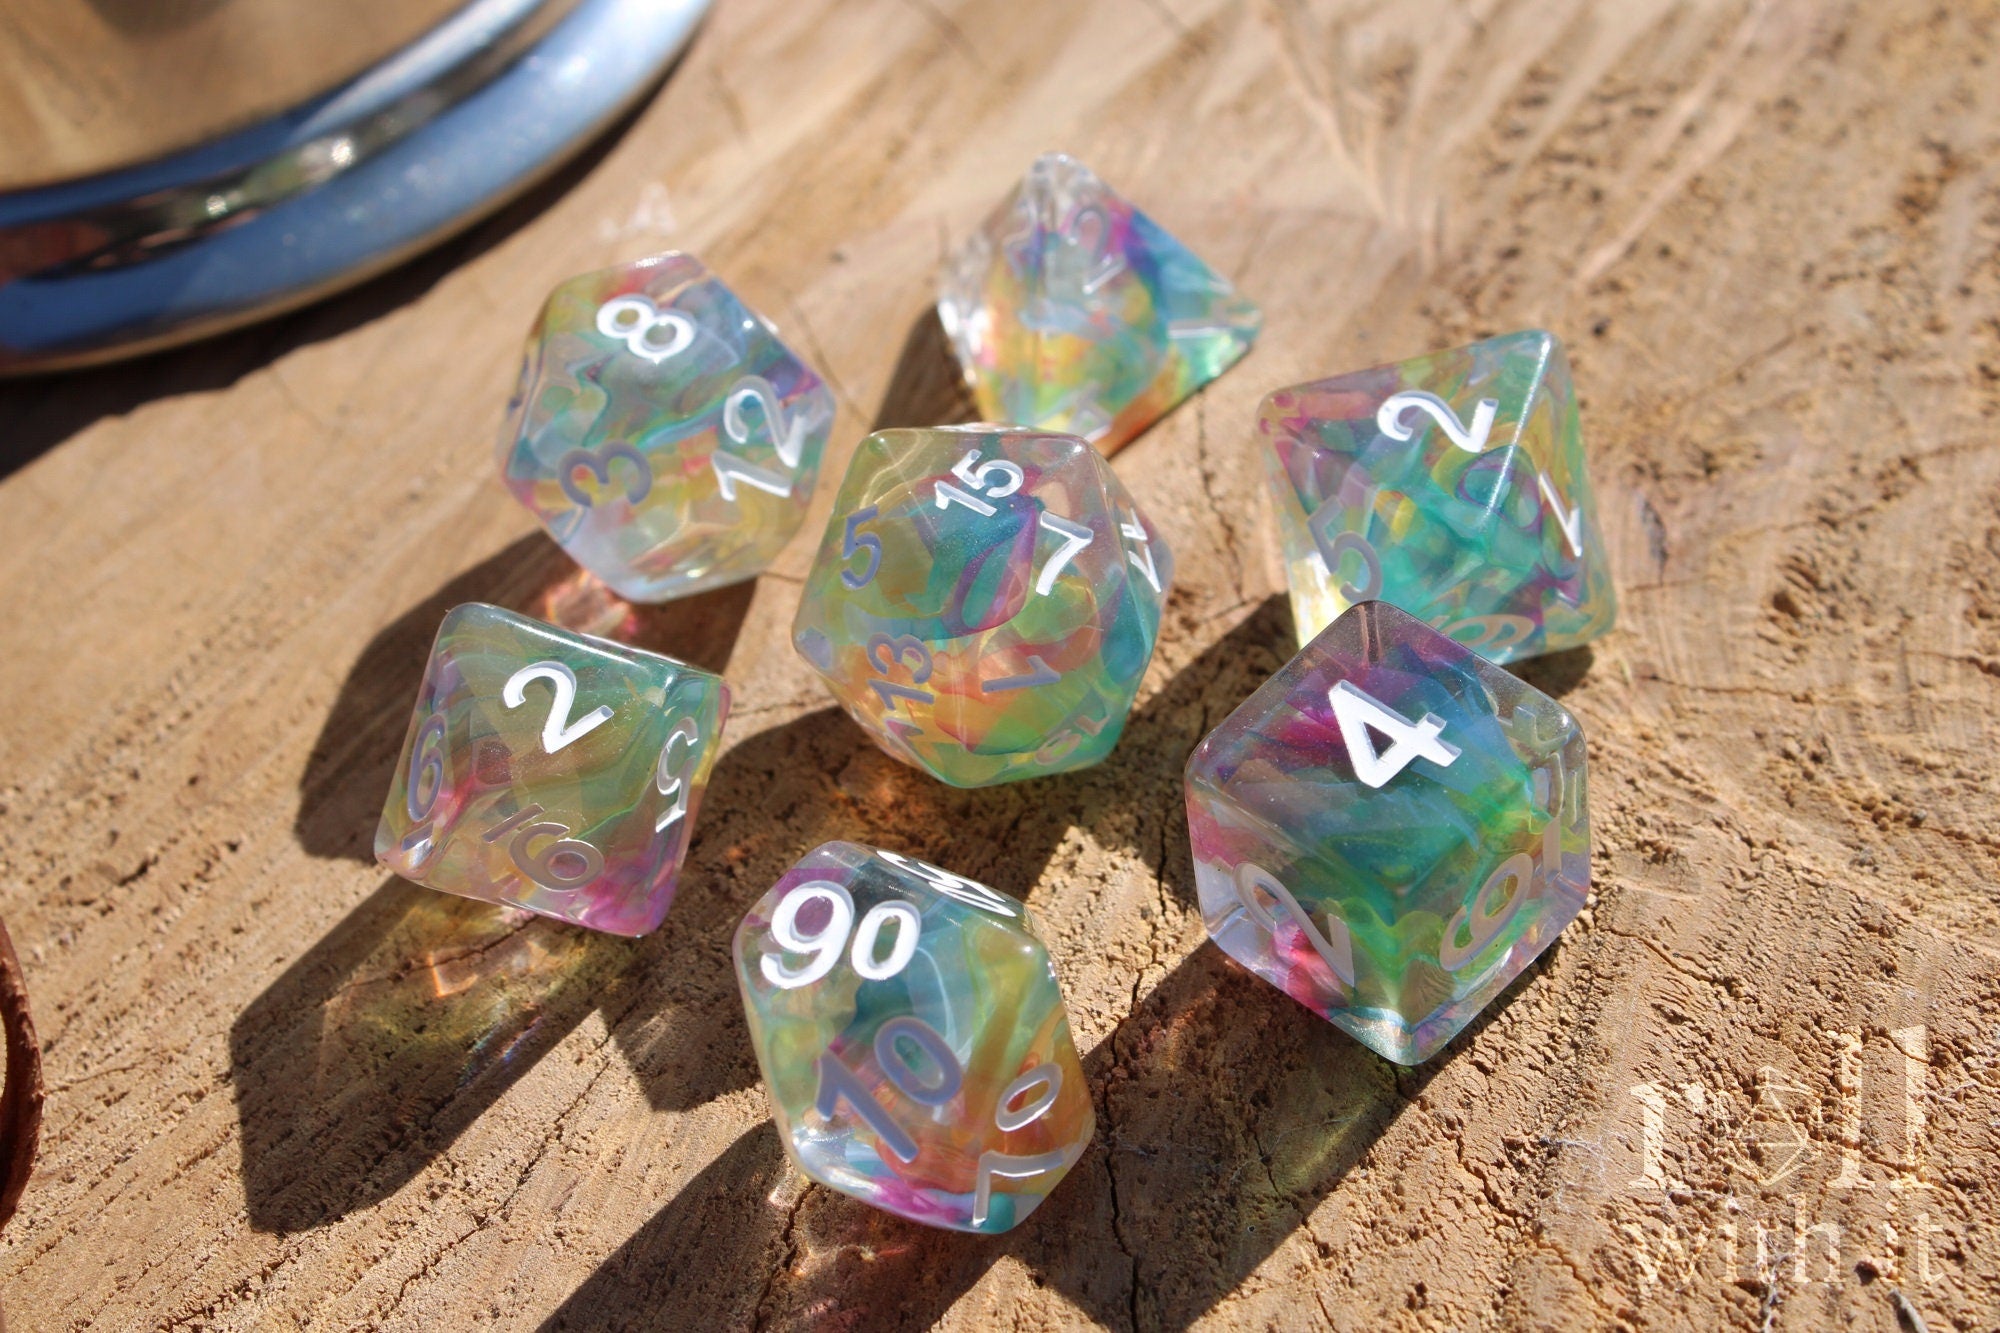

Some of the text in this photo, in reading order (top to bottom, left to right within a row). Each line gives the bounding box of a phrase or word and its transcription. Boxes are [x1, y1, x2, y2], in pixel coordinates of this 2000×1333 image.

[596, 293, 694, 364] 8
[710, 375, 802, 502] 12
[1377, 390, 1499, 452] 2
[559, 441, 652, 508] 3
[933, 448, 1024, 518] 15
[840, 504, 883, 591] 5
[1035, 510, 1094, 597] 7
[1306, 495, 1382, 602] 5
[502, 660, 615, 754] 2
[867, 632, 935, 711] 13
[1328, 679, 1463, 789] 4
[760, 880, 921, 988] 90
[815, 1015, 962, 1164] 10
